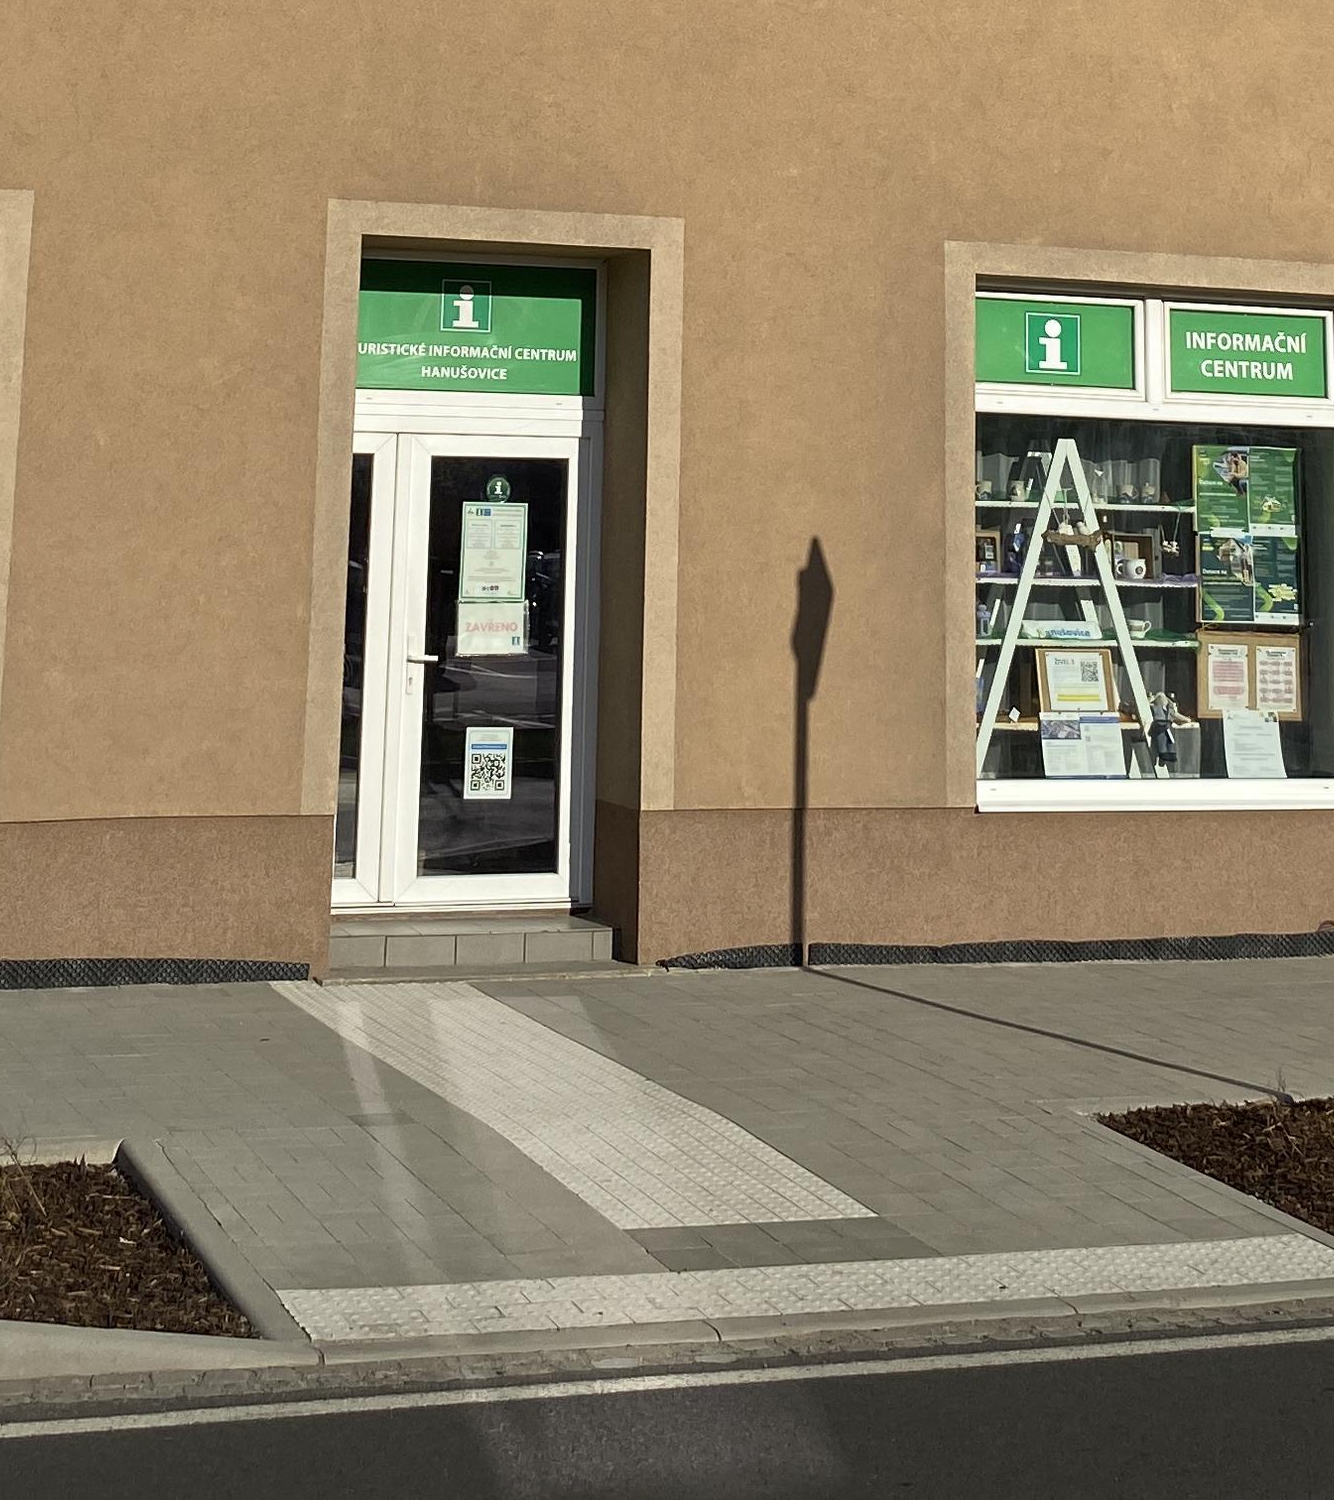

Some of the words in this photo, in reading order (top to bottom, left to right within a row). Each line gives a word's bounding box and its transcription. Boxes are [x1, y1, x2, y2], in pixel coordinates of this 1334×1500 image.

[357, 342, 427, 357] URISTICKÉ
[428, 344, 513, 360] INFORMAČNÍ
[514, 347, 578, 362] CENTRUM
[1185, 331, 1307, 354] INFORMAČNÍ
[420, 363, 508, 380] HANUŠOVICE
[1200, 359, 1294, 381] CENTRUM
